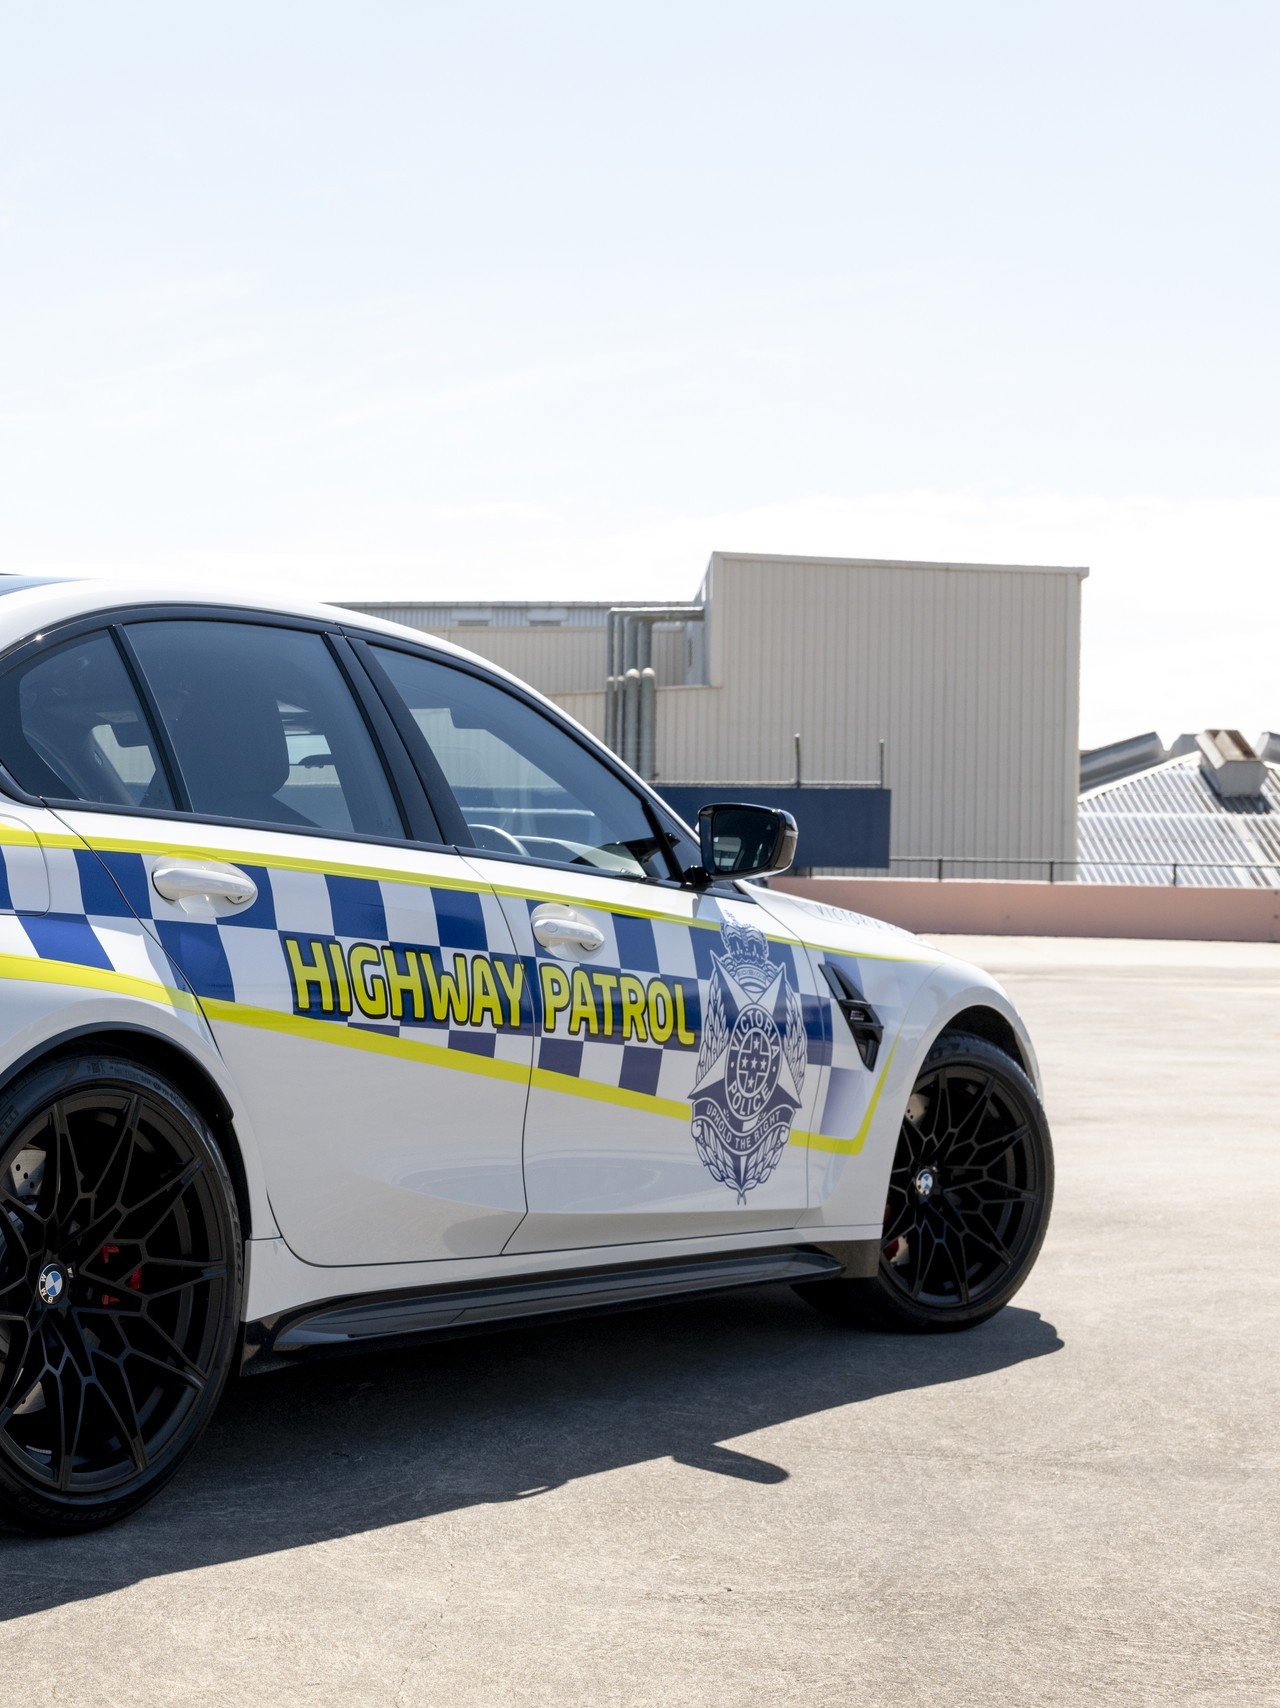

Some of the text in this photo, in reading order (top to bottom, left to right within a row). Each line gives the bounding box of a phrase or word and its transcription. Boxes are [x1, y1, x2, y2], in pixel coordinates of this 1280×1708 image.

[284, 937, 698, 1047] HIGHWAY PATROL
[731, 1010, 780, 1059] VICTORIA
[728, 1080, 771, 1116] POLICE
[706, 1104, 781, 1150] UPHOLD THE RIGHT
